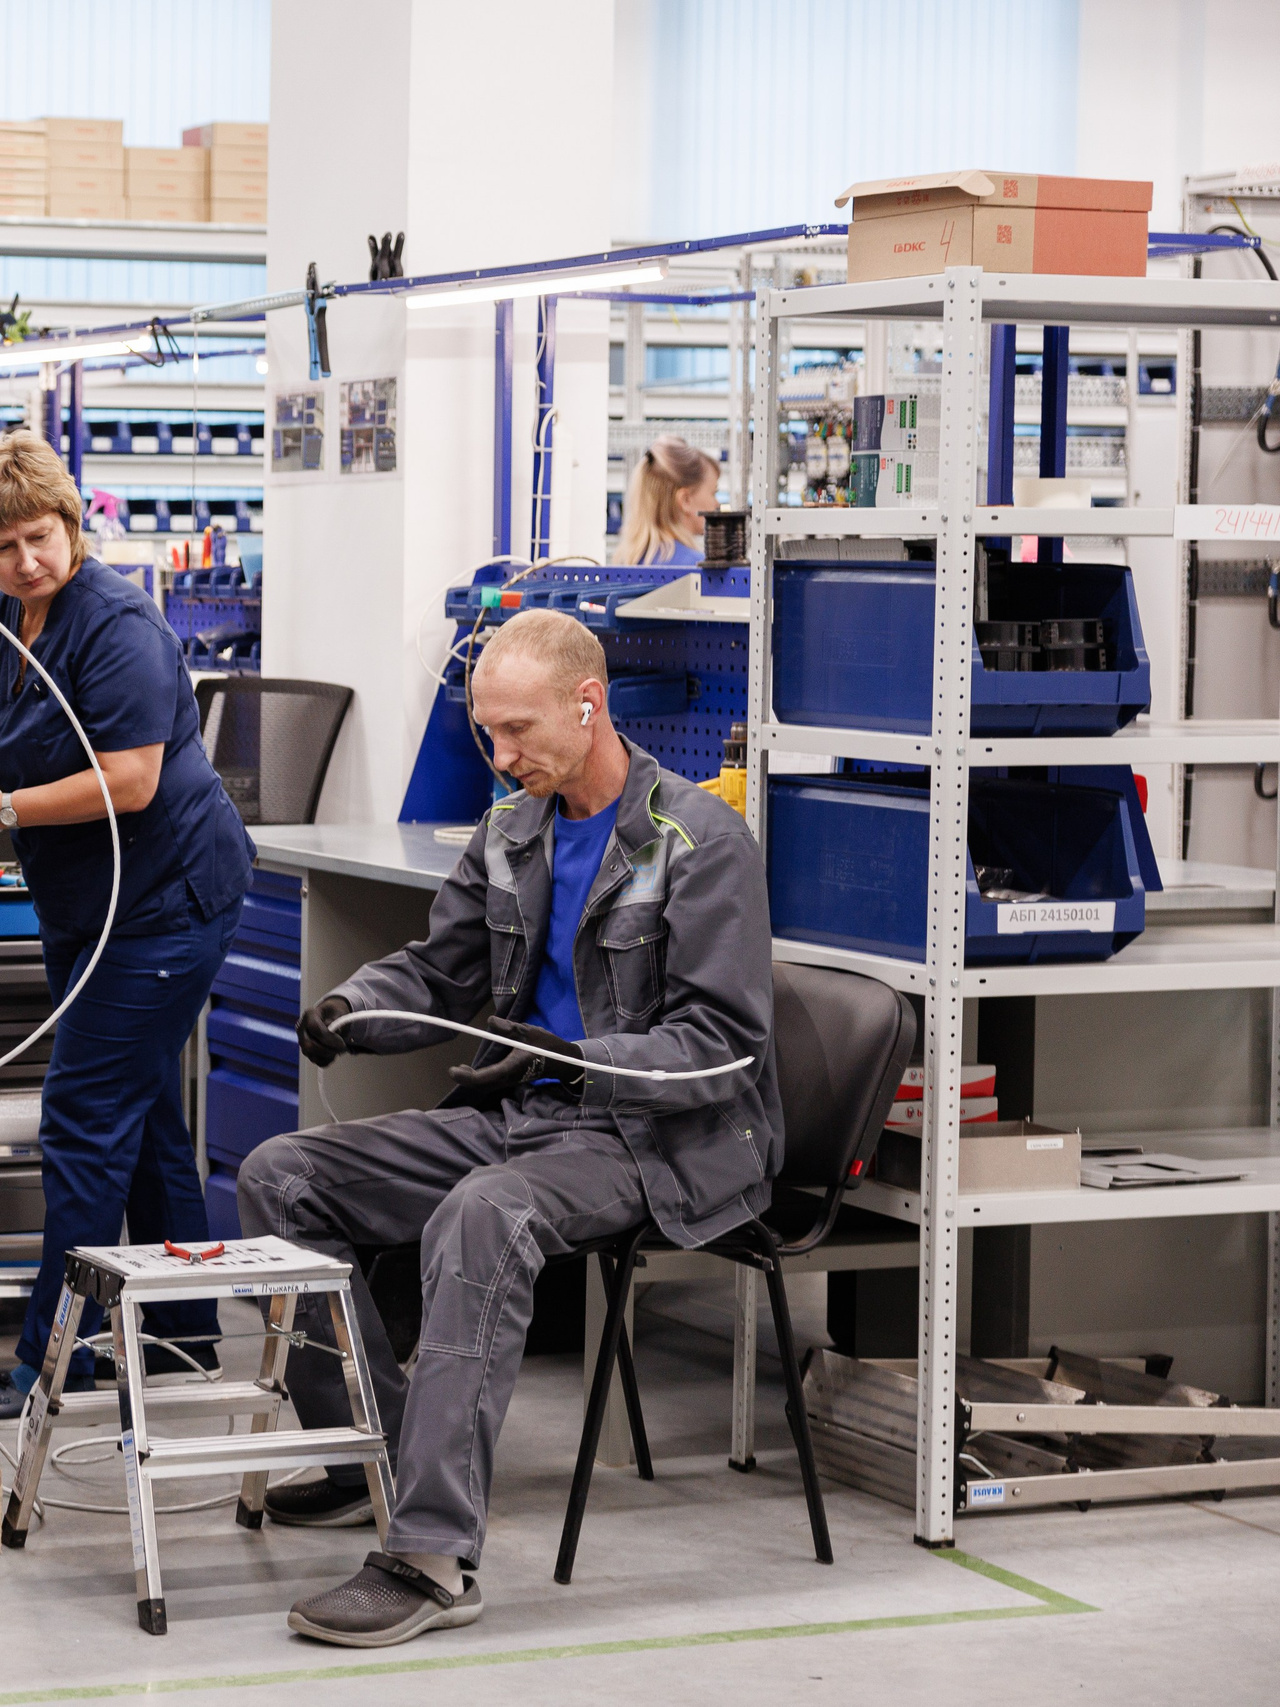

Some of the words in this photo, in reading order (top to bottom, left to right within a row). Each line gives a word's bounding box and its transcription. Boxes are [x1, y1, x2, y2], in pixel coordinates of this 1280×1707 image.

[903, 241, 926, 252] DKC
[940, 219, 955, 263] 4
[1009, 910, 1037, 922] АБП
[1040, 908, 1101, 921] 24150101
